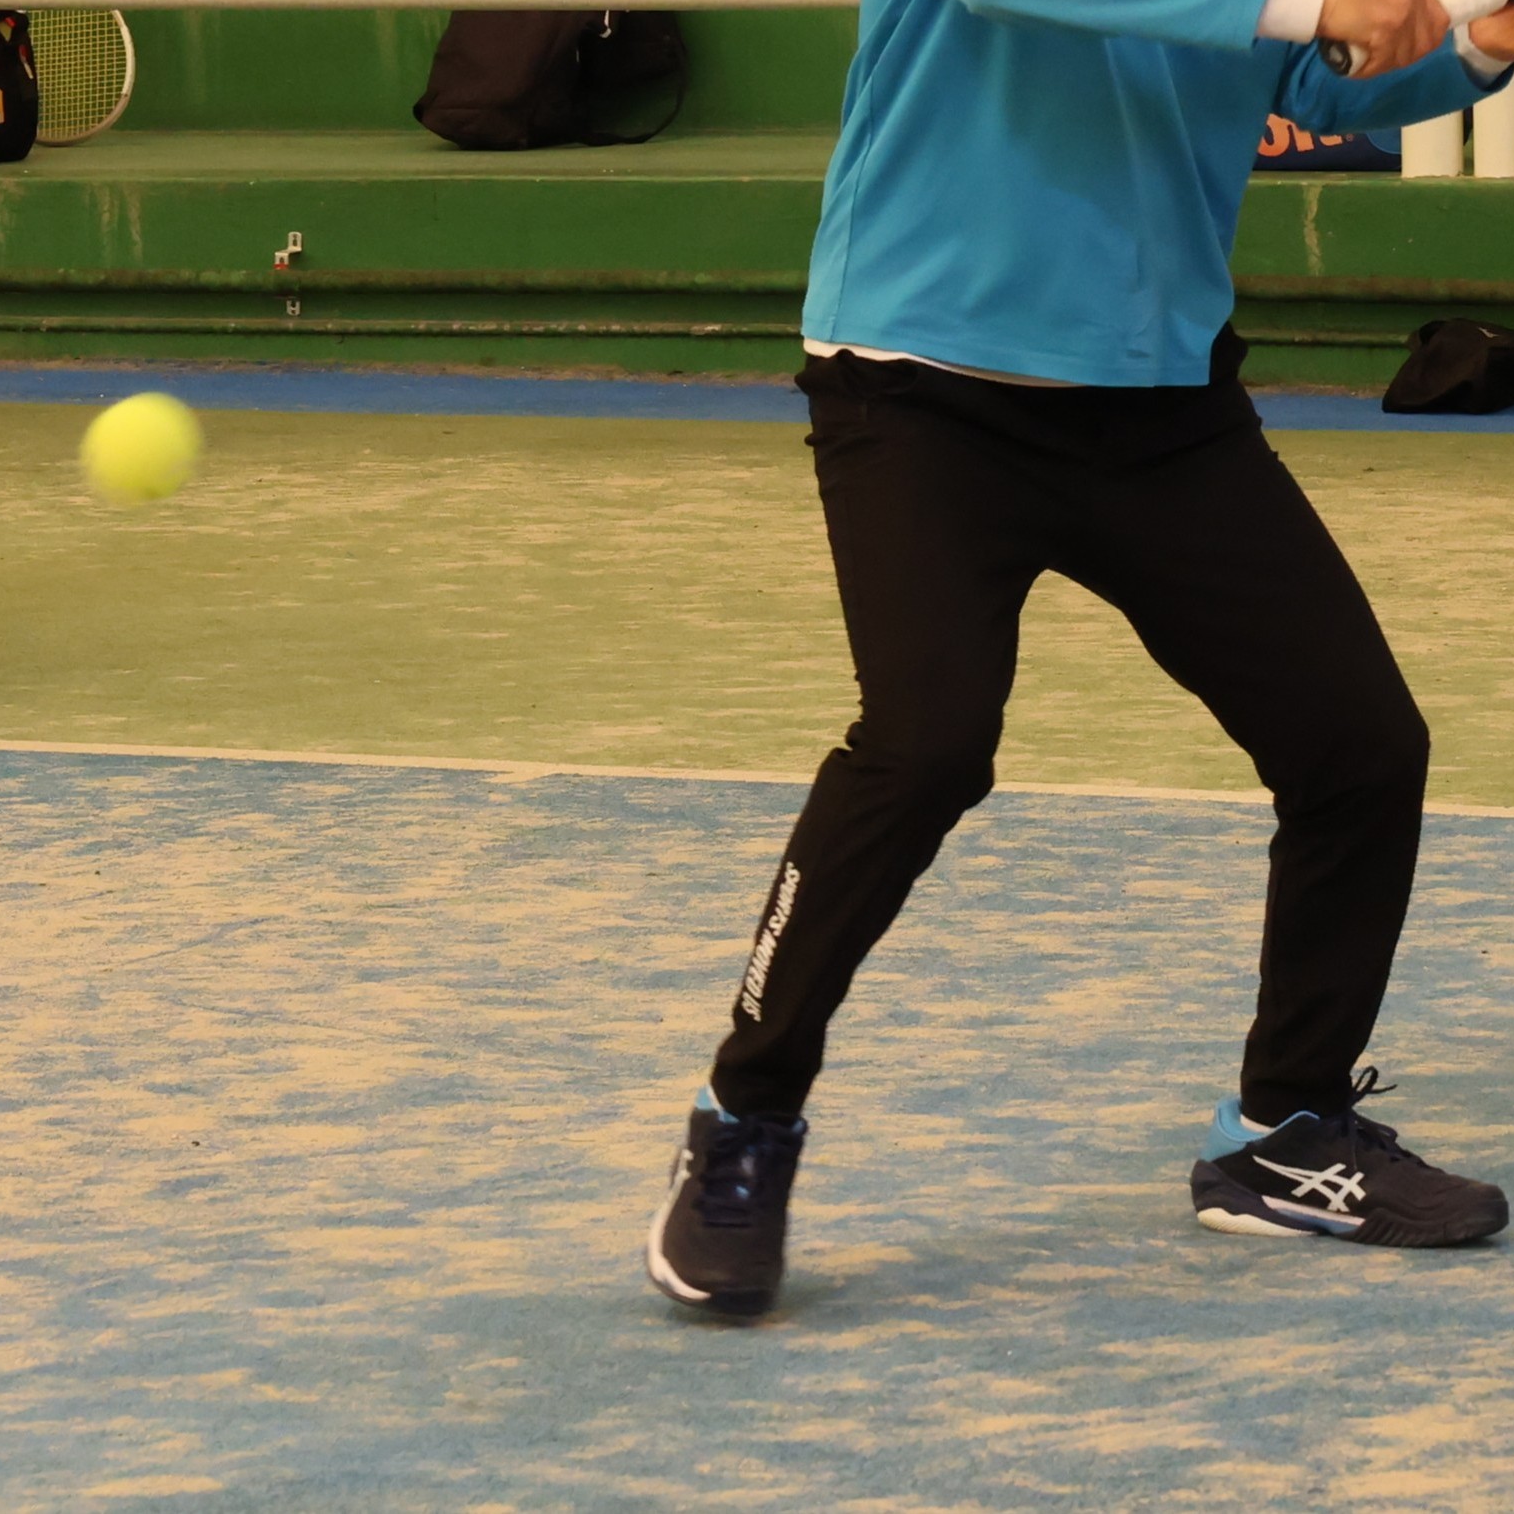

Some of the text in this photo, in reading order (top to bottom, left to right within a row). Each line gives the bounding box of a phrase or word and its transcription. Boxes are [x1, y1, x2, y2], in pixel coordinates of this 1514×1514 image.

[741, 861, 802, 1023] SPORTS MOVED US
